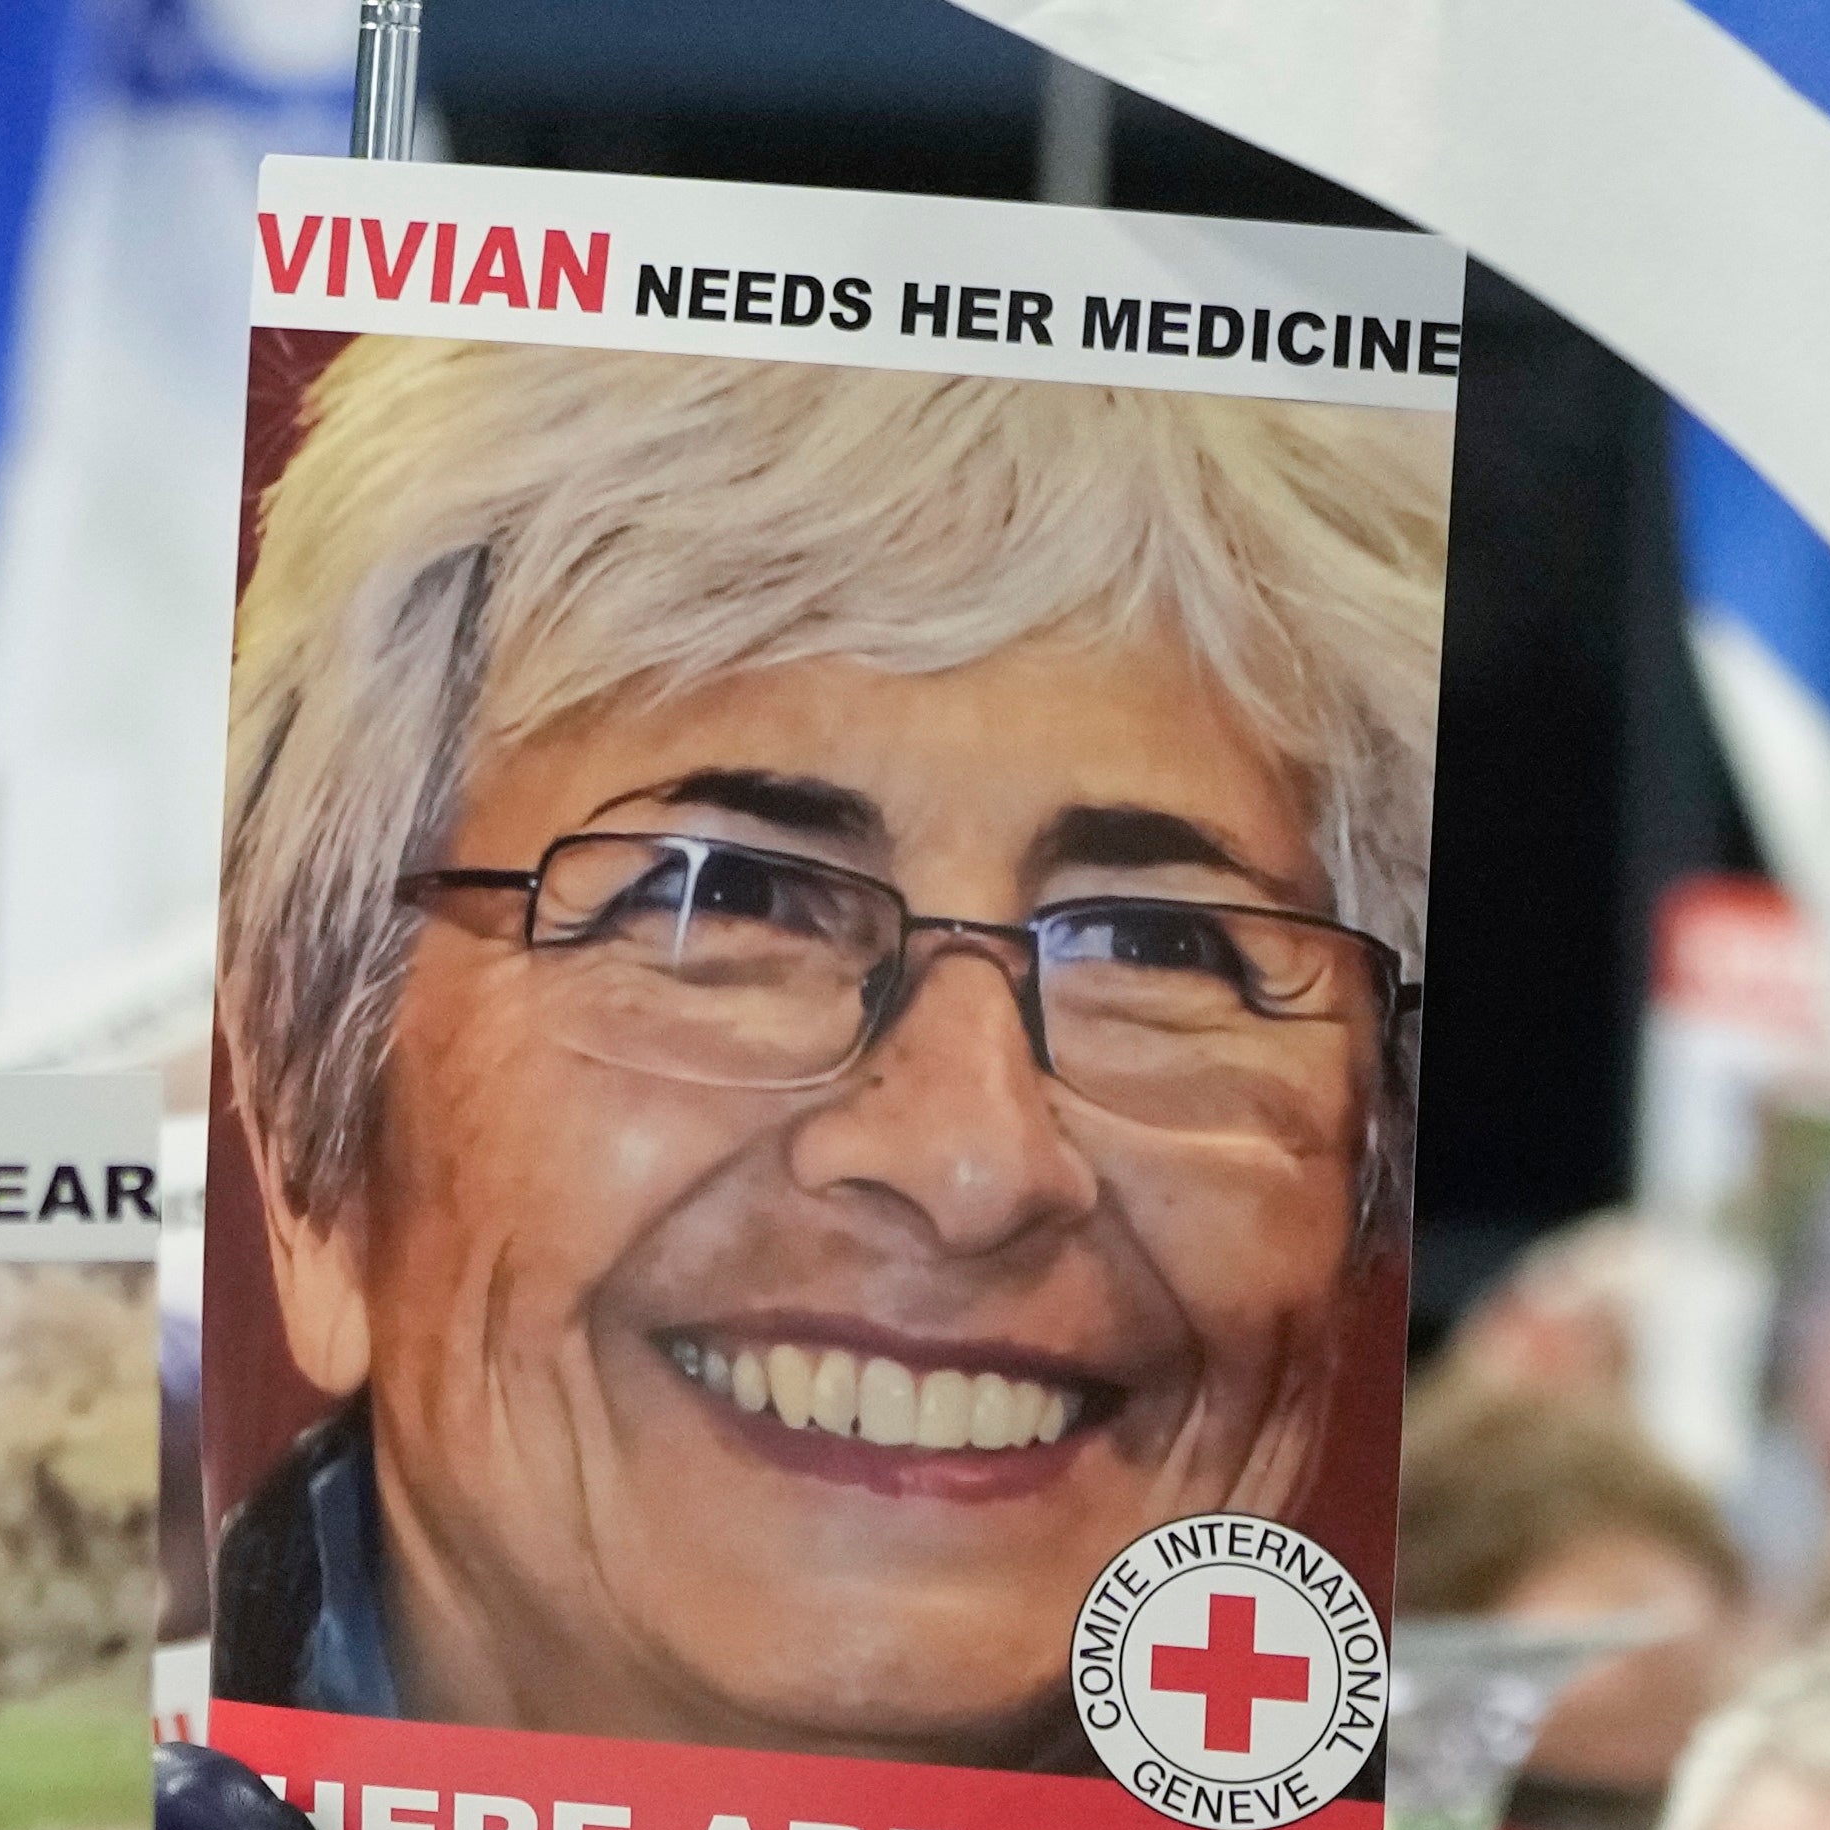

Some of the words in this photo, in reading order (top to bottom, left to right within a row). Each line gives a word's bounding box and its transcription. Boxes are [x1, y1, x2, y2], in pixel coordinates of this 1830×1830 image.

[256, 211, 611, 313] VIVIAN
[634, 263, 873, 332] NEEDS
[899, 281, 1054, 347] HER
[1081, 294, 1462, 378] MEDICINE
[1079, 1560, 1151, 1731] COMITE
[1154, 1521, 1382, 1754] INTERNATIONAL
[1132, 1759, 1318, 1825] GENEVE
